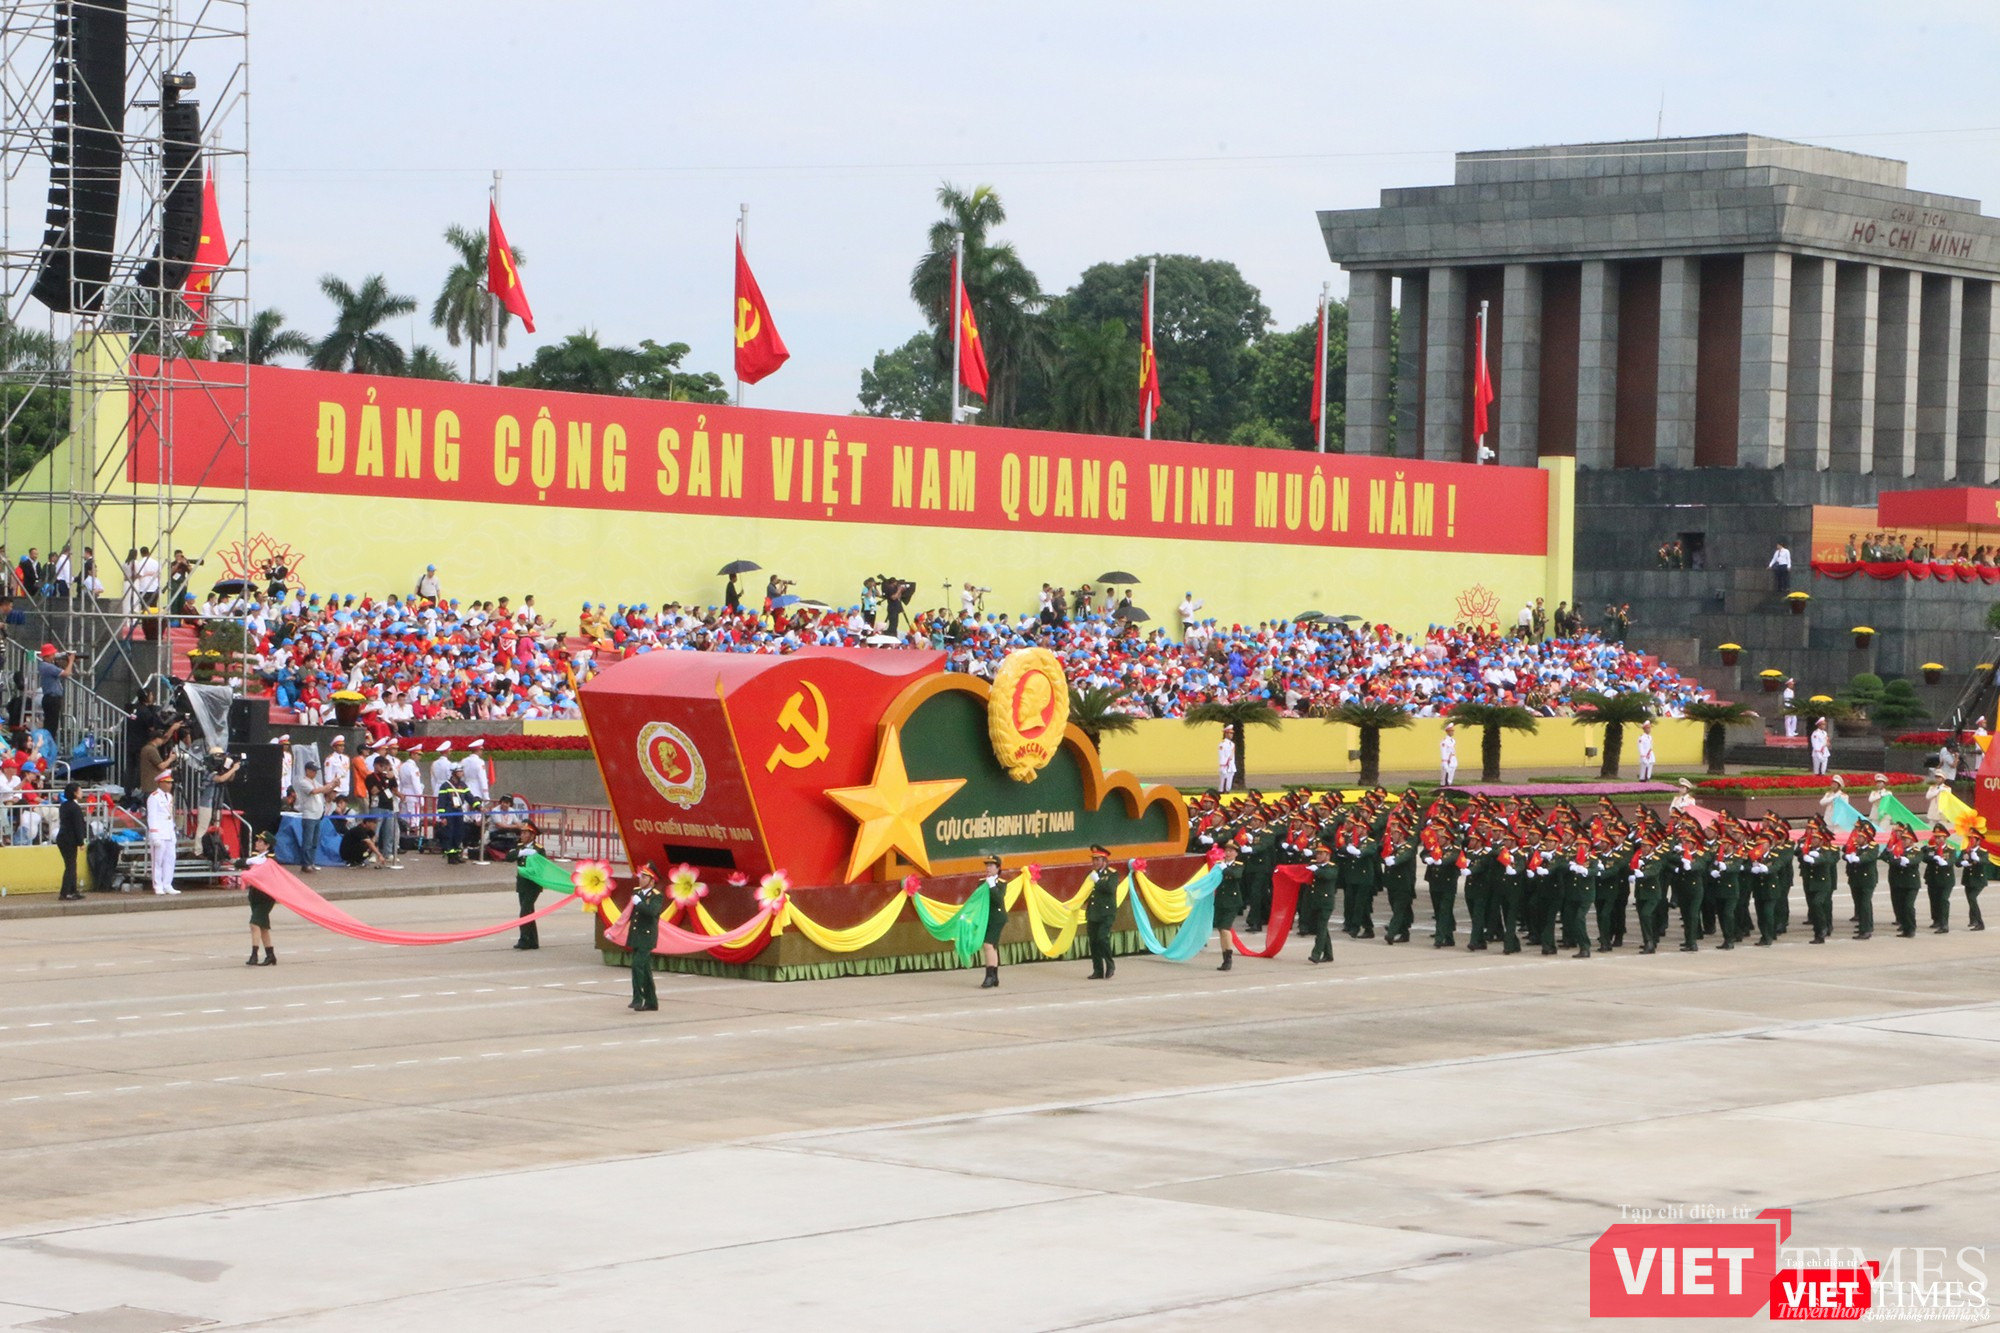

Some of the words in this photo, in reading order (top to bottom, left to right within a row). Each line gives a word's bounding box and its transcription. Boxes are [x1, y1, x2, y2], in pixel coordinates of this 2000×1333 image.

[316, 387, 461, 482] ĐẢNG
[494, 407, 627, 500] CỘNG
[657, 414, 744, 499] SẢN
[771, 429, 867, 517] VIỆT
[892, 446, 976, 512] NAM
[1001, 453, 1128, 522] QUANG
[1150, 463, 1234, 526] VINH
[1255, 465, 1350, 533] MUÔN
[1369, 470, 1435, 537] NĂM
[1984, 776, 2000, 792] CỰ
[633, 818, 654, 836] CỰU
[729, 827, 754, 841] NAM
[936, 817, 961, 846] CỰU
[962, 810, 995, 840] CHIẾN
[996, 815, 1023, 837] BINH
[1024, 809, 1049, 839] VIỆT
[1049, 811, 1075, 833] NAM
